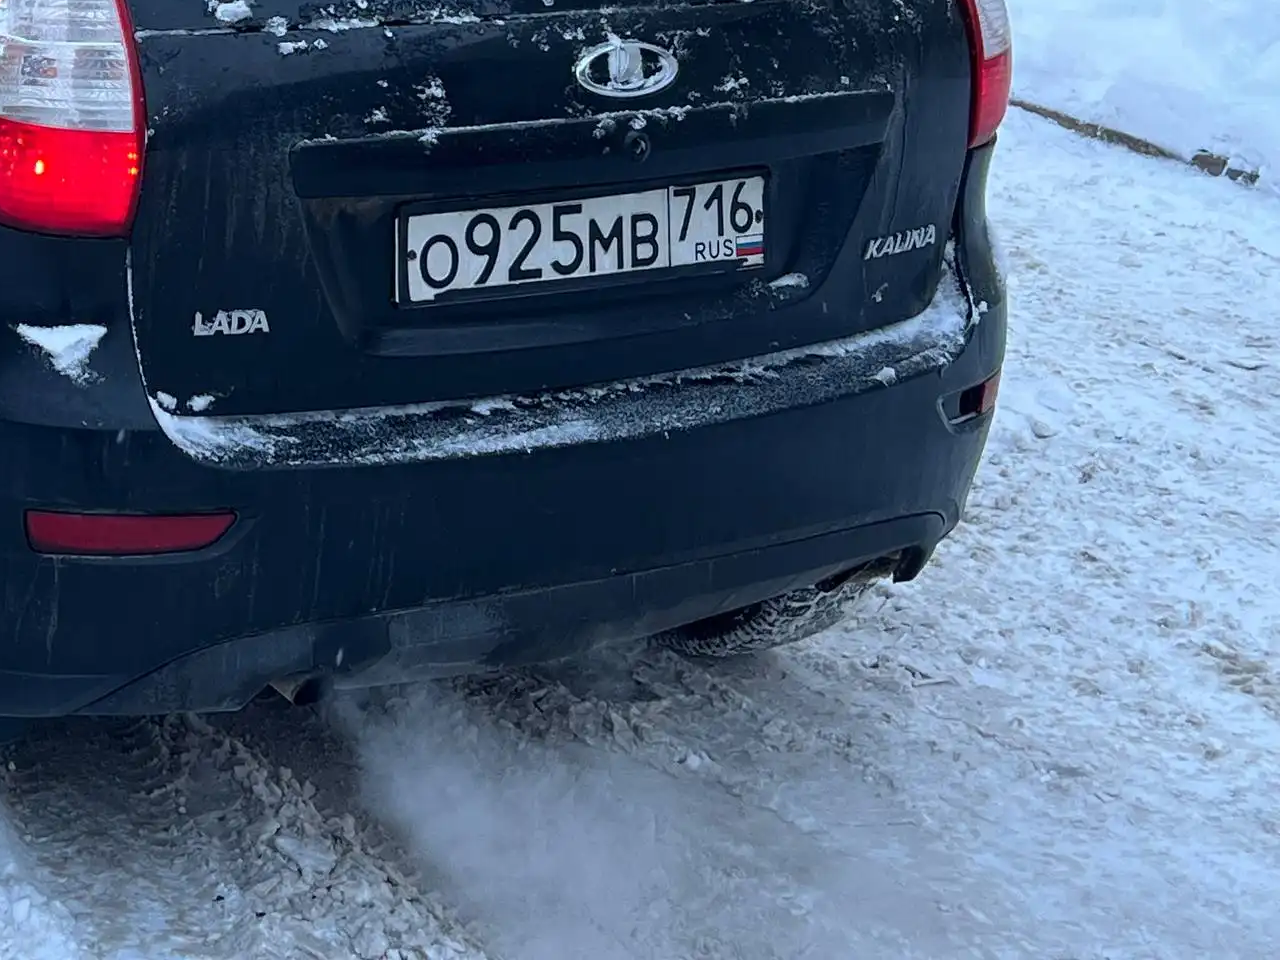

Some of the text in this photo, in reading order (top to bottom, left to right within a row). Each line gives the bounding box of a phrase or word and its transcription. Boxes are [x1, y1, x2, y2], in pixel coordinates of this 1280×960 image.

[672, 181, 754, 242] 716
[694, 238, 734, 261] RUS
[864, 223, 936, 260] KALINA
[193, 308, 270, 336] LADA
